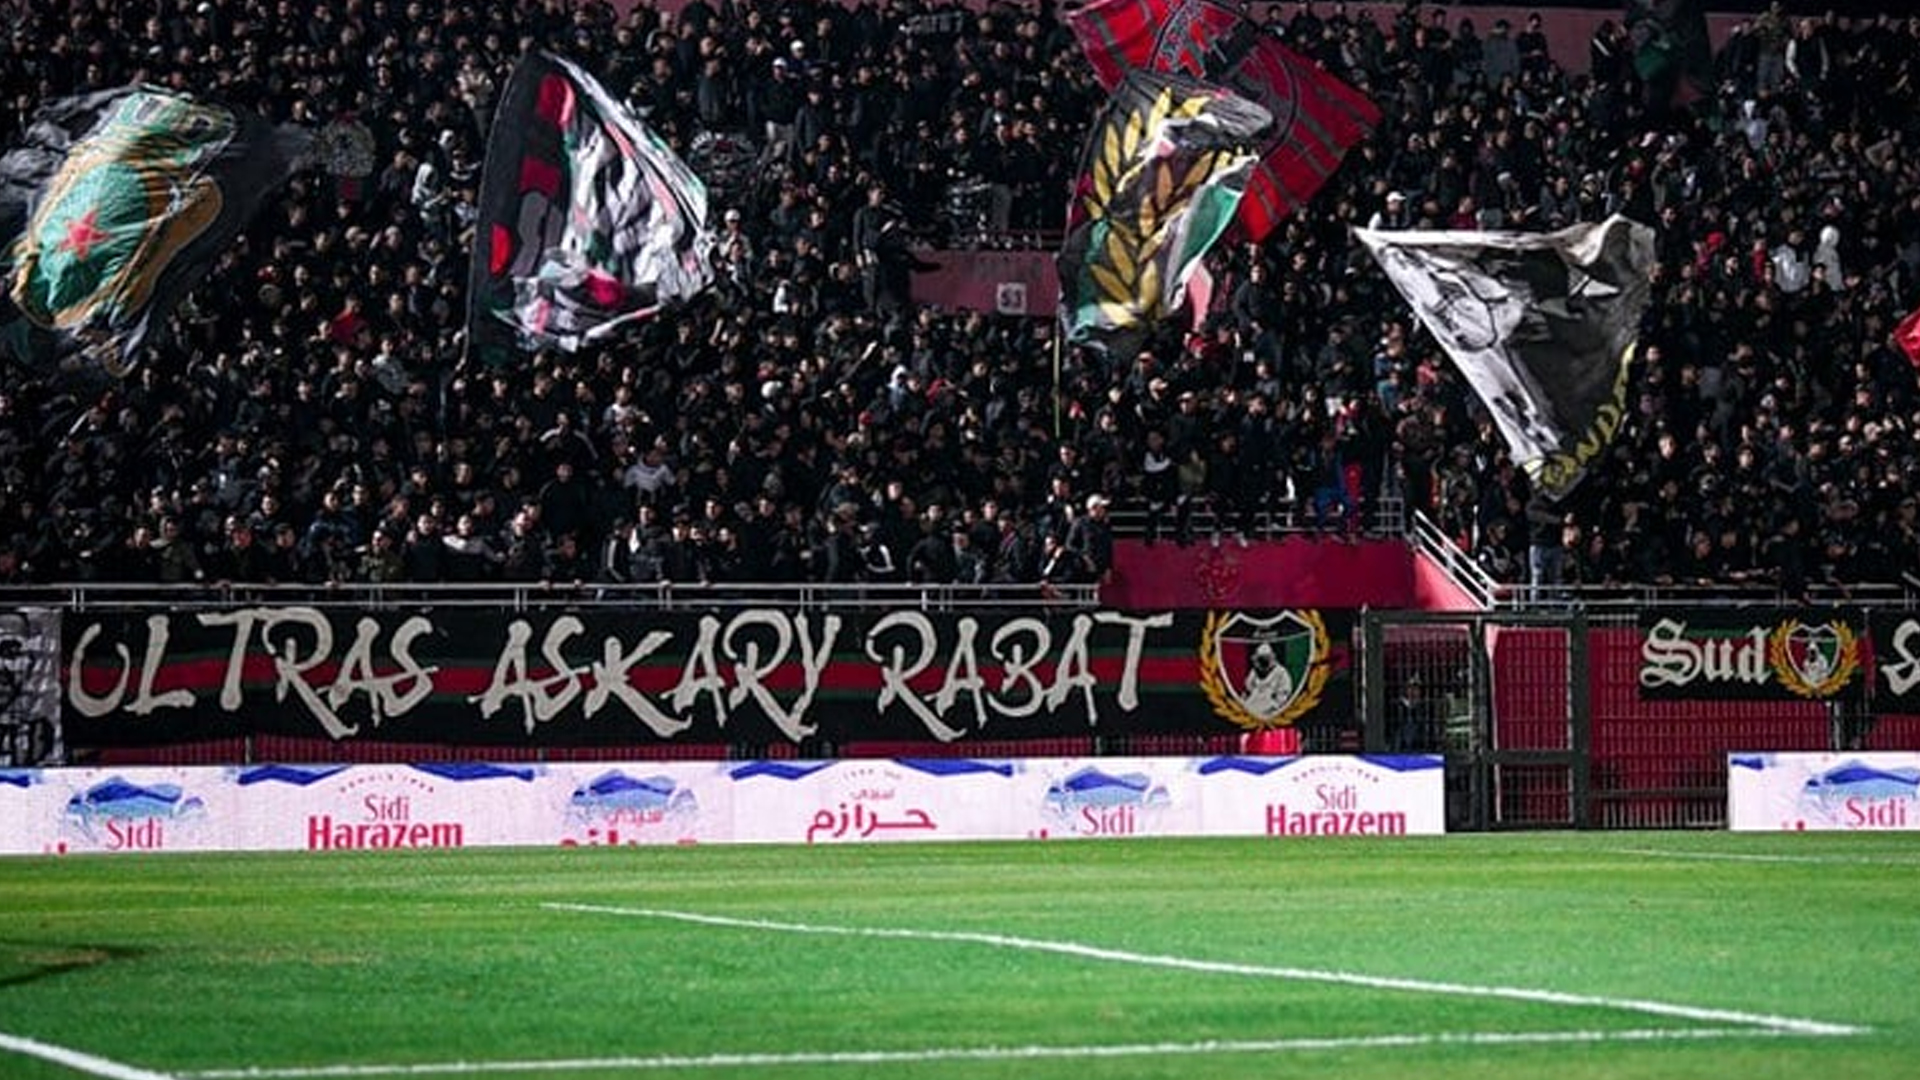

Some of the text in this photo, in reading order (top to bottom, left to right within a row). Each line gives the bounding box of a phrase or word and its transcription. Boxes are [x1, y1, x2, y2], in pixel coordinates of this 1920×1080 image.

[1639, 617, 1773, 688] Sud
[68, 607, 1174, 742] ULTRAS ASKARY RABAT
[363, 793, 410, 822] Sidi
[1316, 783, 1357, 811] Sidi
[1846, 796, 1906, 827] Sidi
[106, 817, 163, 850] Sidi
[308, 815, 464, 849] Harazem
[807, 802, 938, 845] حرازم
[1082, 804, 1135, 836] Sidi
[1266, 804, 1407, 837] Harazem
